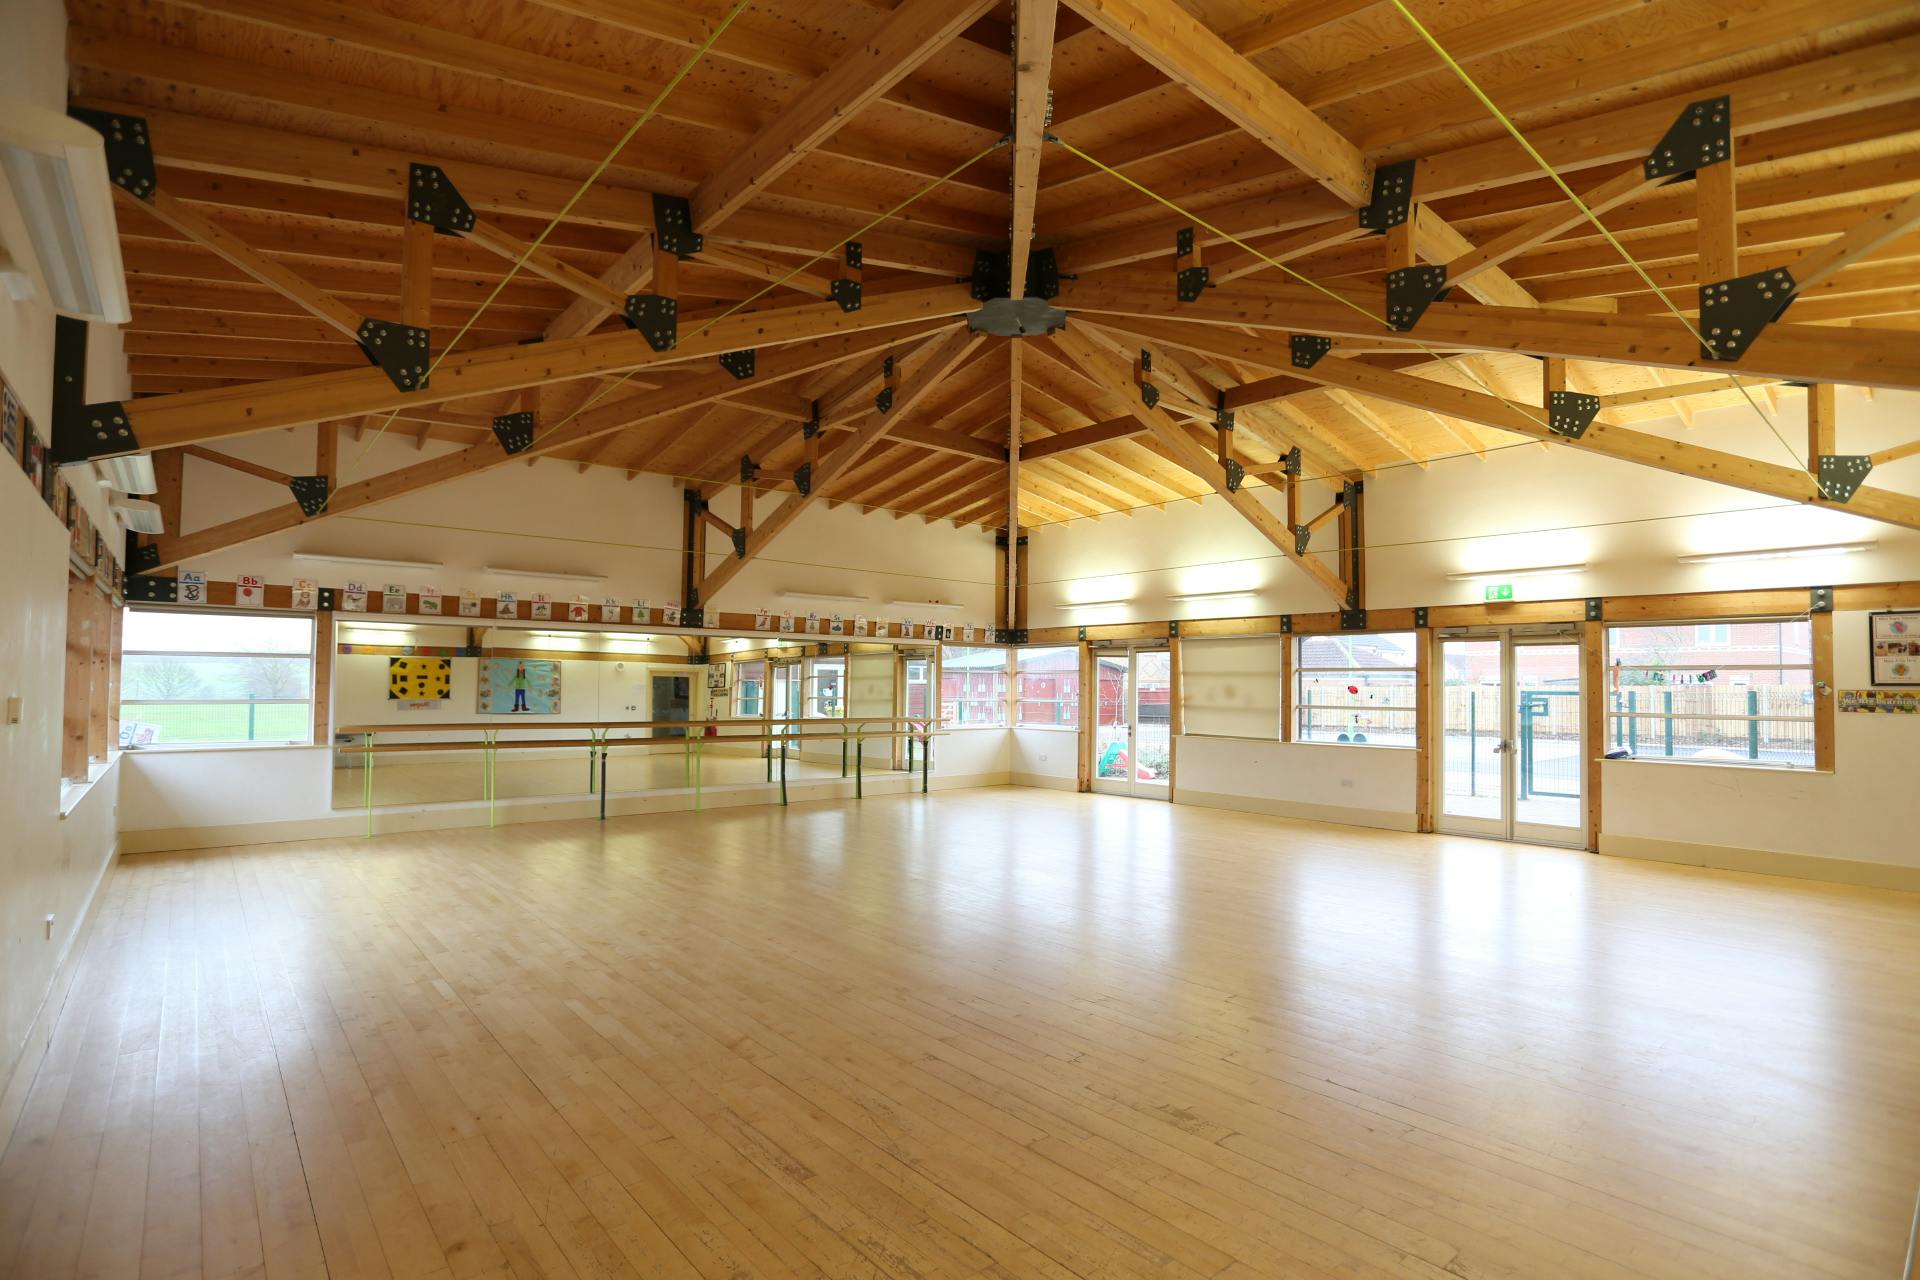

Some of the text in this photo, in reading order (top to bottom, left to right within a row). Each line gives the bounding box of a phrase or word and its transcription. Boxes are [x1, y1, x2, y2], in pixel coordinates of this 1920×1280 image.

[184, 573, 200, 582] Aa
[243, 577, 258, 585] Bb
[299, 580, 312, 588] Cc
[348, 583, 362, 591] Dd
